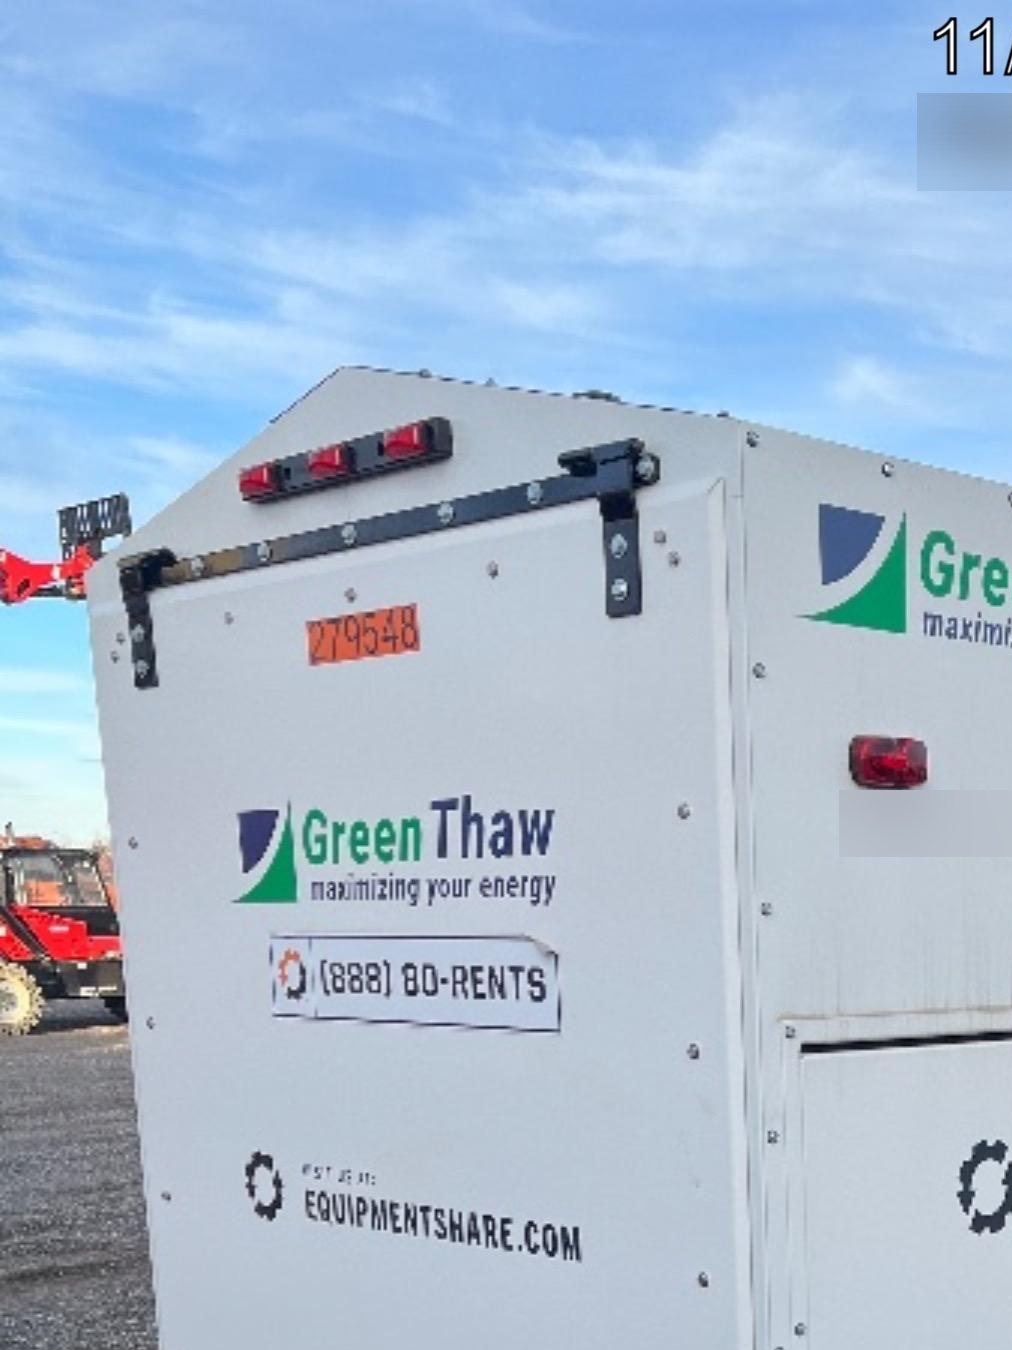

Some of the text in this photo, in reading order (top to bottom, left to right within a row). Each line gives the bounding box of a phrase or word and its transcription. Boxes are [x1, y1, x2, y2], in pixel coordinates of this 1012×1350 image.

[310, 872, 557, 907] maximizing your energy
[319, 958, 547, 1002] (888) 80-RENTS
[304, 1189, 583, 1263] EQUIPMENTSHARE.COM
